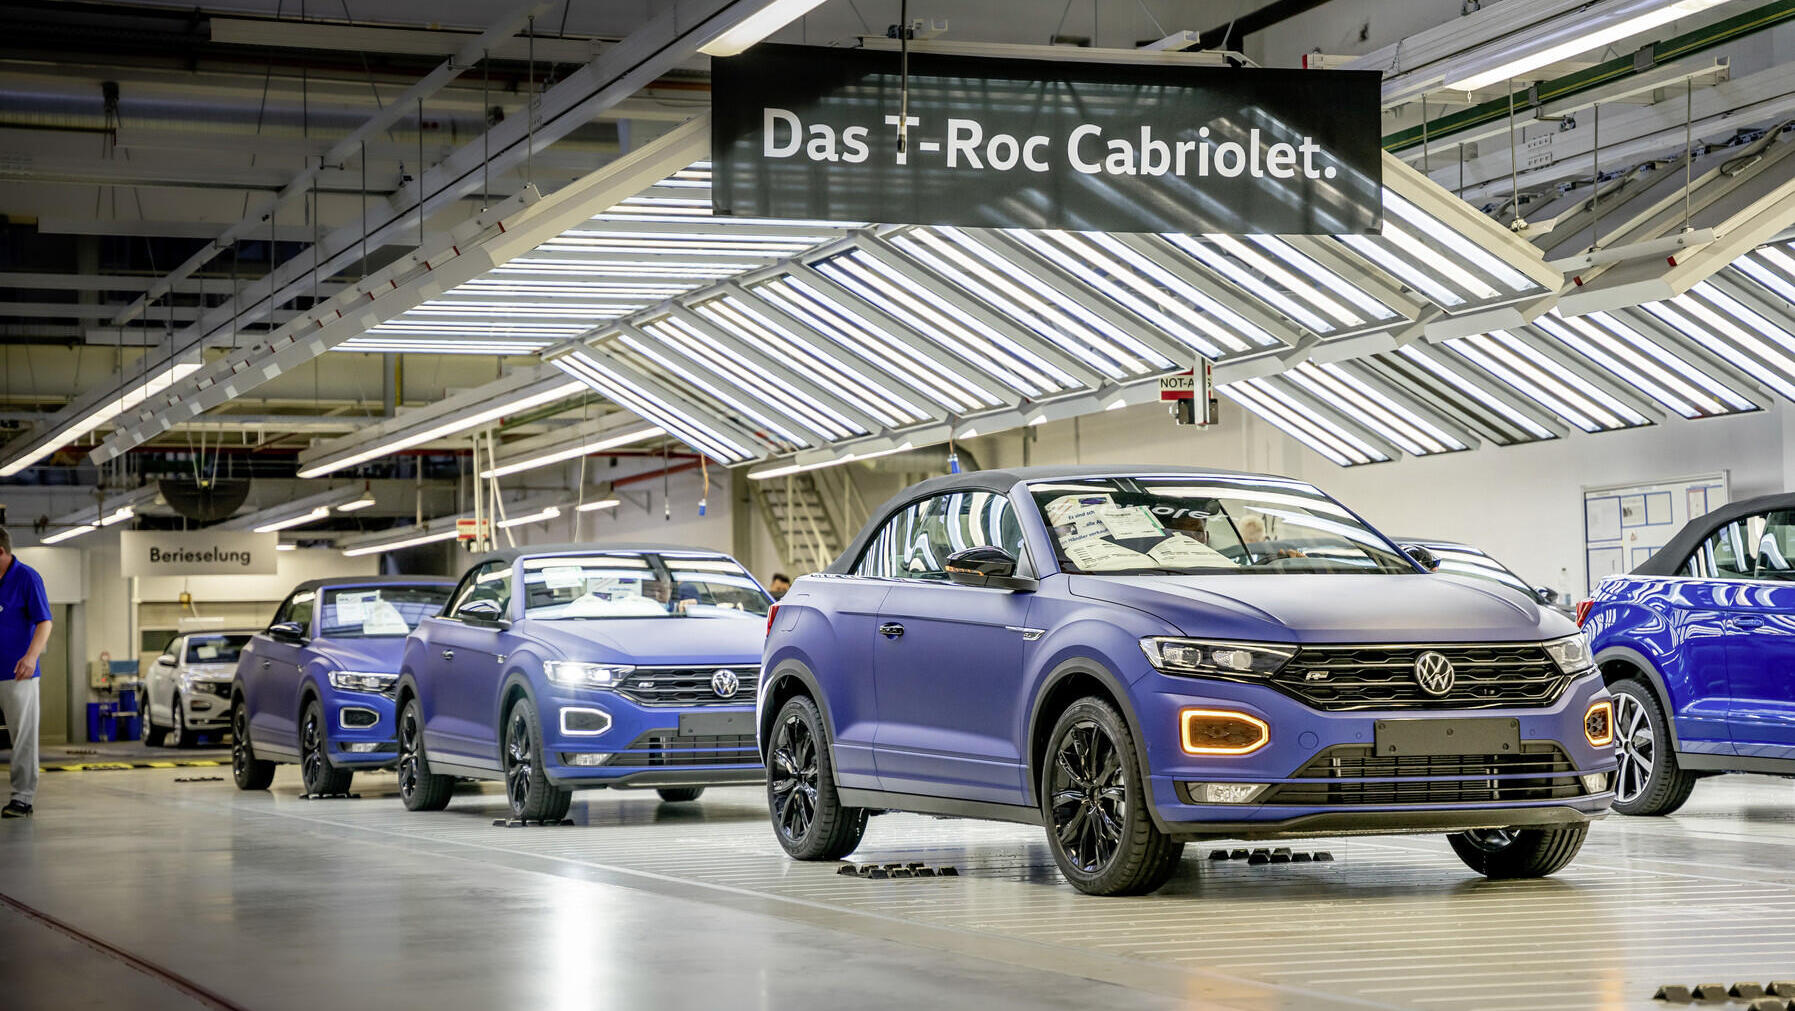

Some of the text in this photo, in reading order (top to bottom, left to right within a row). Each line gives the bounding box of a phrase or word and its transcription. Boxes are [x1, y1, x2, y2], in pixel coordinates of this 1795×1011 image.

[763, 107, 1338, 179] Das T-Roc Cabriolet.
[150, 546, 252, 566] Berieselung
